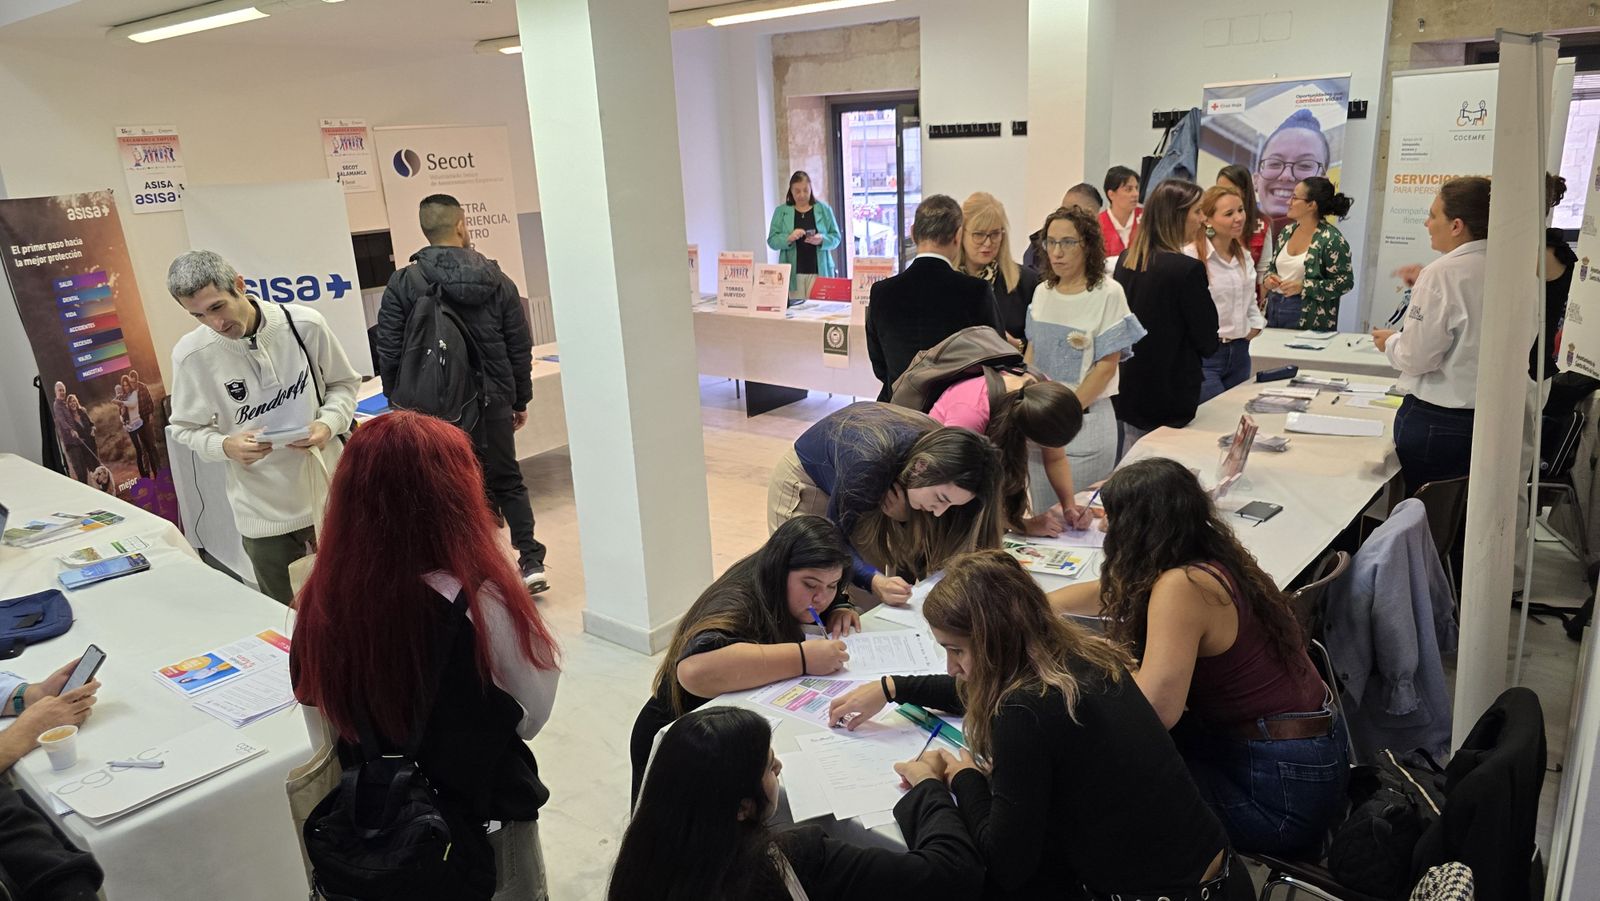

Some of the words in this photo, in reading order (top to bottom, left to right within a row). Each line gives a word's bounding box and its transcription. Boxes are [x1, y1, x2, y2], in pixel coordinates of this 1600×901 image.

[427, 152, 475, 171] Secot
[145, 180, 173, 189] ASISA
[1414, 186, 1440, 194] PERSO
[135, 191, 177, 205] asisa
[67, 205, 102, 221] asisa
[11, 245, 21, 255] El
[22, 243, 47, 255] primer
[48, 241, 65, 252] paso
[65, 237, 83, 247] hacia
[15, 258, 23, 267] la
[24, 256, 47, 267] mejor
[48, 250, 83, 263] protección
[244, 275, 321, 303] sisa
[69, 322, 96, 333] ACCIDENTES
[235, 365, 309, 425] Bendorff
[118, 477, 138, 492] mejor
